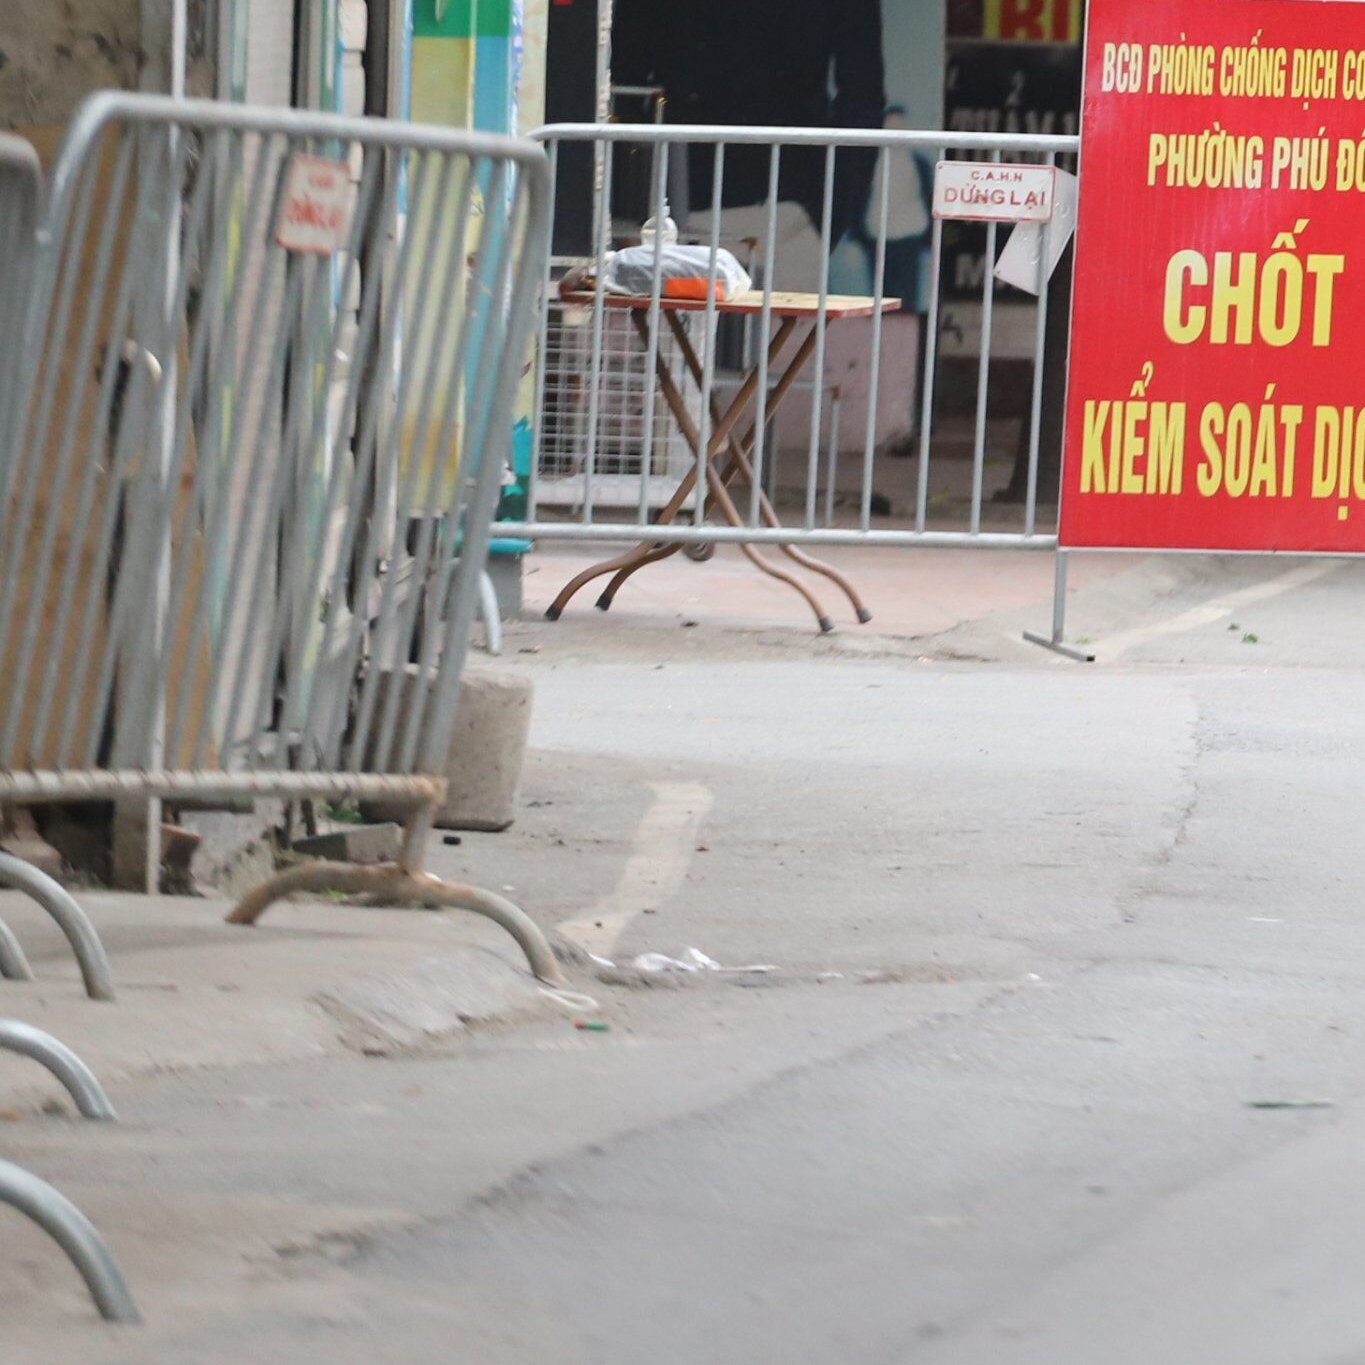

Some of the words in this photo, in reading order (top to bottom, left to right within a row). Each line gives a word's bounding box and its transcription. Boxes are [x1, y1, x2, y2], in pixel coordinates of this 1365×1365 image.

[1101, 43, 1142, 93] BCĐ
[1147, 32, 1215, 97] PHÒNG
[1219, 29, 1285, 99] CHỐNG
[1291, 49, 1337, 110] DỊCH
[1147, 122, 1263, 190] PHƯỜNG
[1270, 126, 1329, 192] PHÚ
[1010, 190, 1045, 210] LẠI
[1163, 219, 1345, 347] CHỐT
[1079, 361, 1186, 495] KIỂM
[1196, 383, 1303, 499] SOÁT
